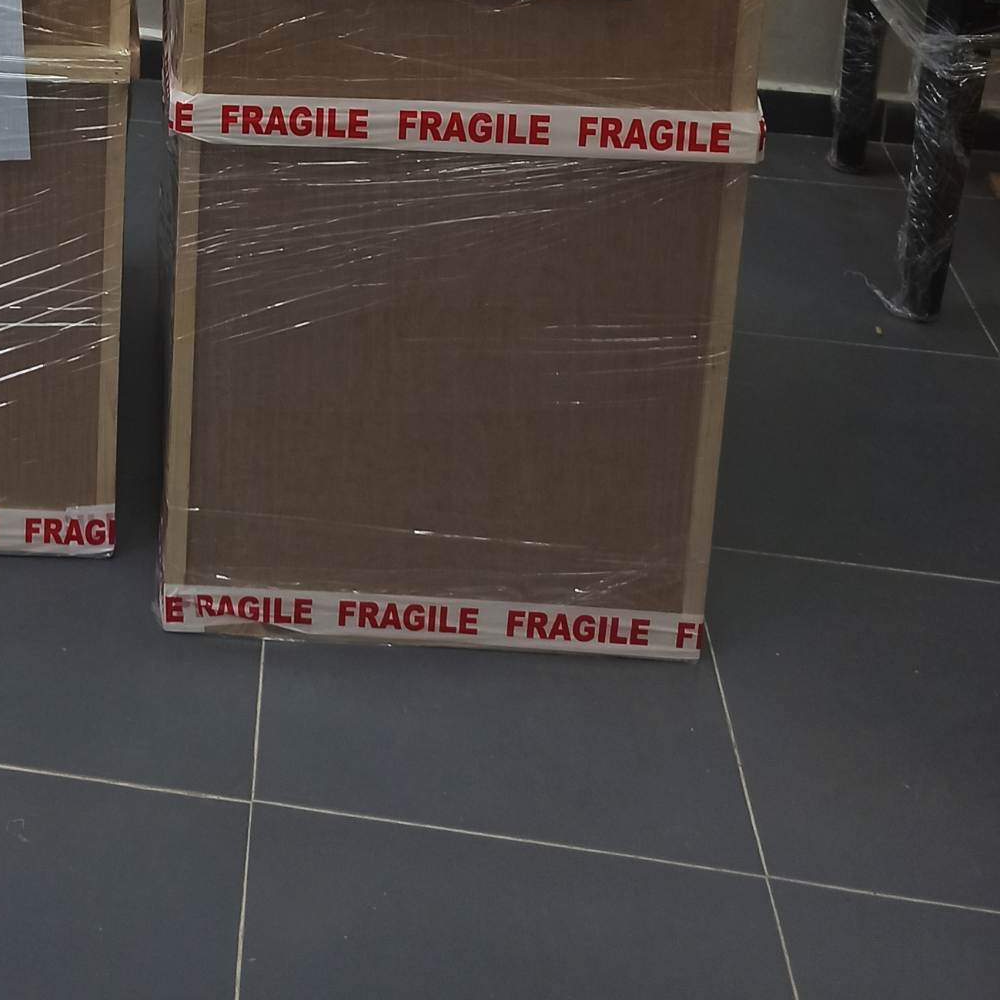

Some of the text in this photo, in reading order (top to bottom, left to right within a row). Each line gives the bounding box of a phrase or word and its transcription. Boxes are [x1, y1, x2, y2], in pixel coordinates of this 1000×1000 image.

[221, 104, 369, 140] FRAGILE
[398, 111, 551, 147] FRAGILE
[578, 117, 732, 154] FRAGILE
[24, 517, 116, 546] FRAGI
[196, 594, 313, 625] RAGILE
[338, 601, 479, 636] FRAGILE
[506, 611, 650, 646] FRAGILE
